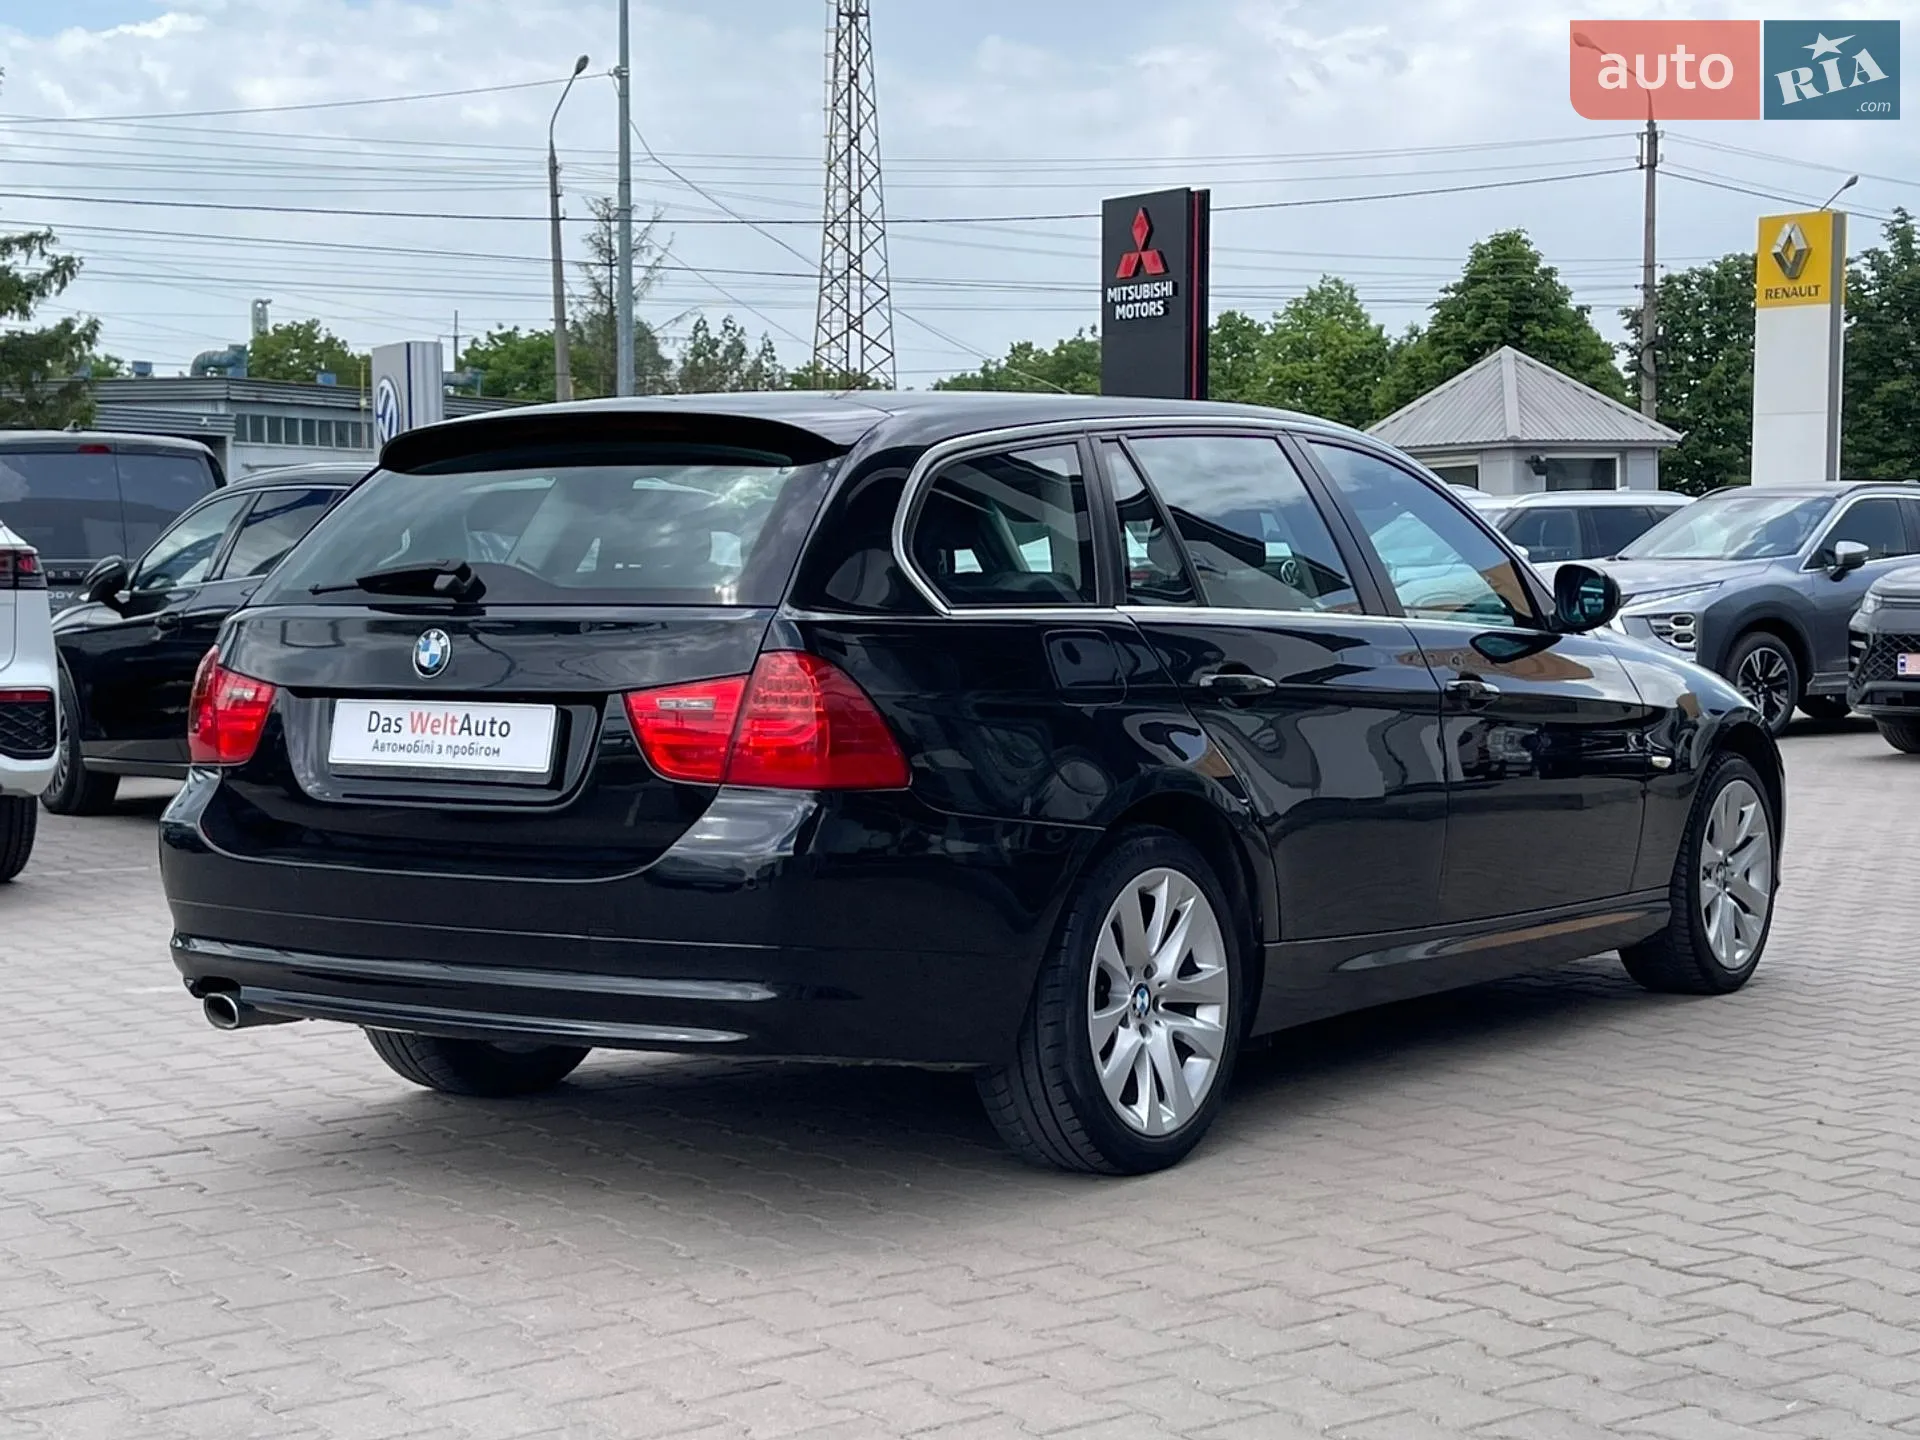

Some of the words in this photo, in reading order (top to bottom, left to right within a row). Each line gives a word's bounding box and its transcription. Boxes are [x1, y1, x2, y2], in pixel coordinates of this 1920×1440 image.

[1106, 281, 1174, 303] MITSUBISHI
[1764, 284, 1822, 300] RENAULT
[1114, 300, 1165, 320] MOTORS
[367, 710, 403, 734] Das
[409, 711, 511, 738] WeltAuto
[371, 739, 435, 755] Автомобілі
[436, 745, 443, 755] з
[445, 742, 501, 758] пробігом
